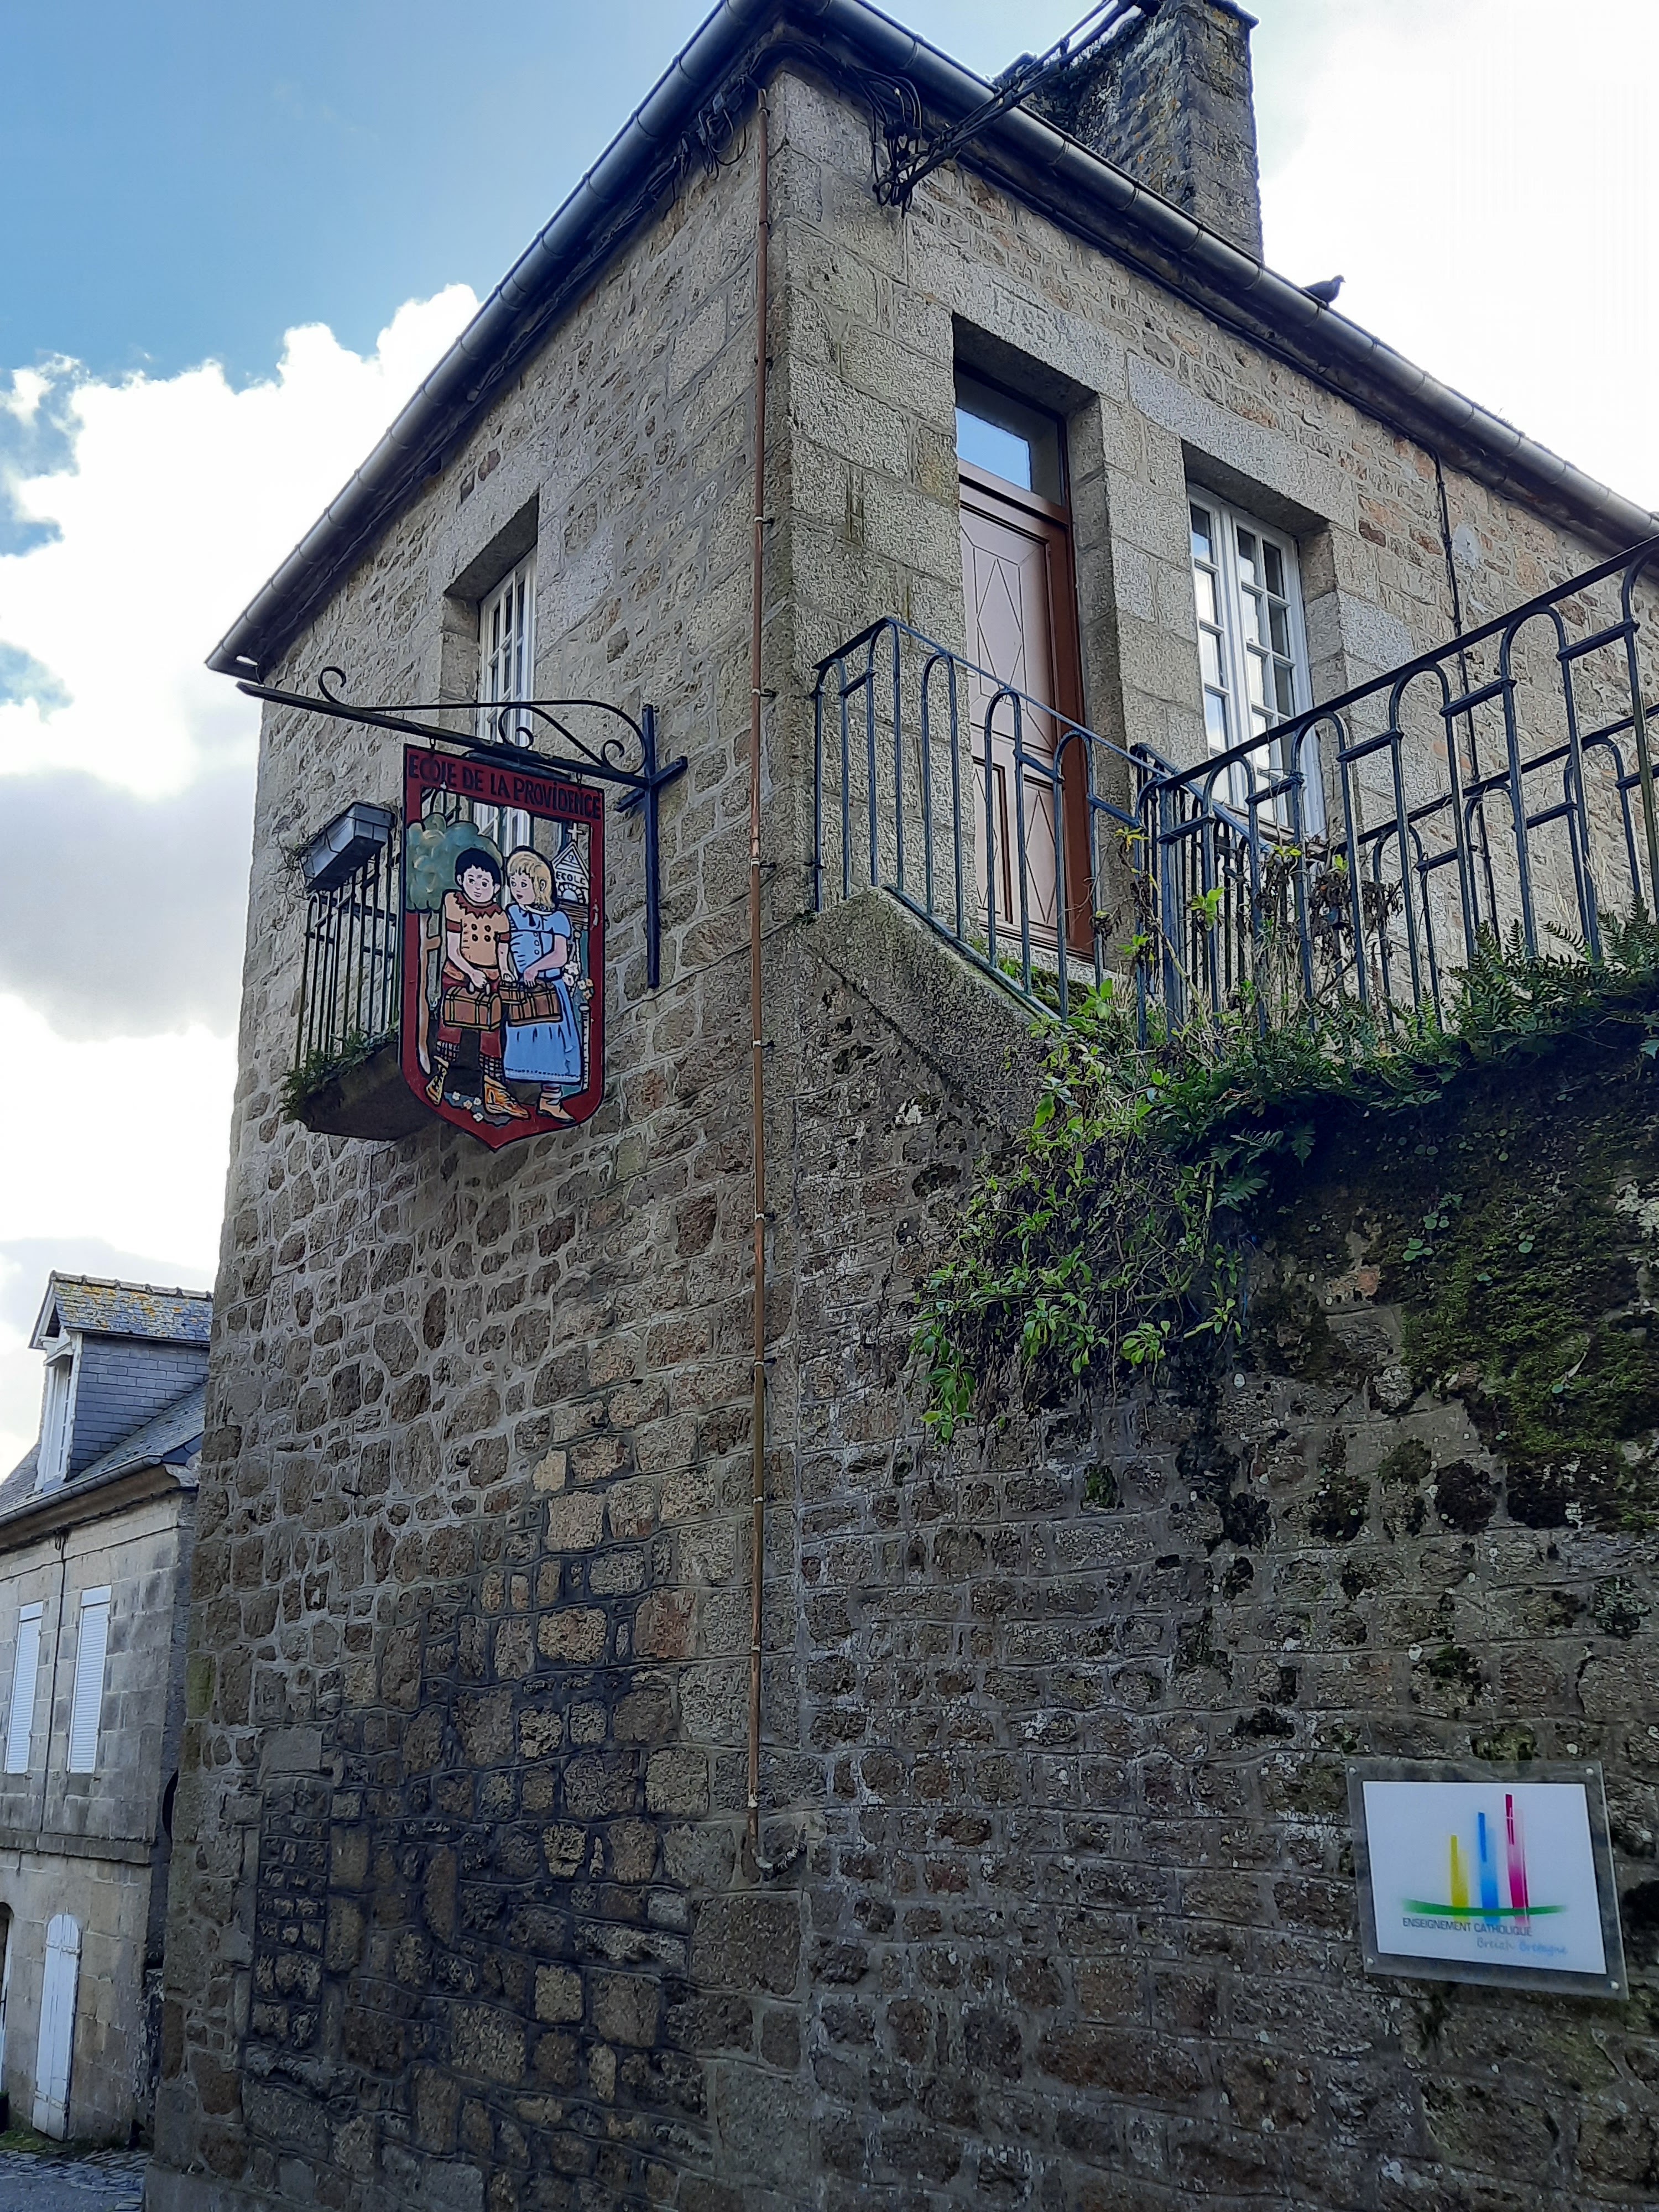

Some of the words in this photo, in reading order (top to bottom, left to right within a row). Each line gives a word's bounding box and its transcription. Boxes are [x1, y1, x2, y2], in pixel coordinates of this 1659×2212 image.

[462, 766, 484, 792] DE
[491, 773, 510, 799] LA
[1402, 1917, 1471, 1932] ENSEIGNEMENT
[1474, 1923, 1533, 1937] CATHOLIQUE
